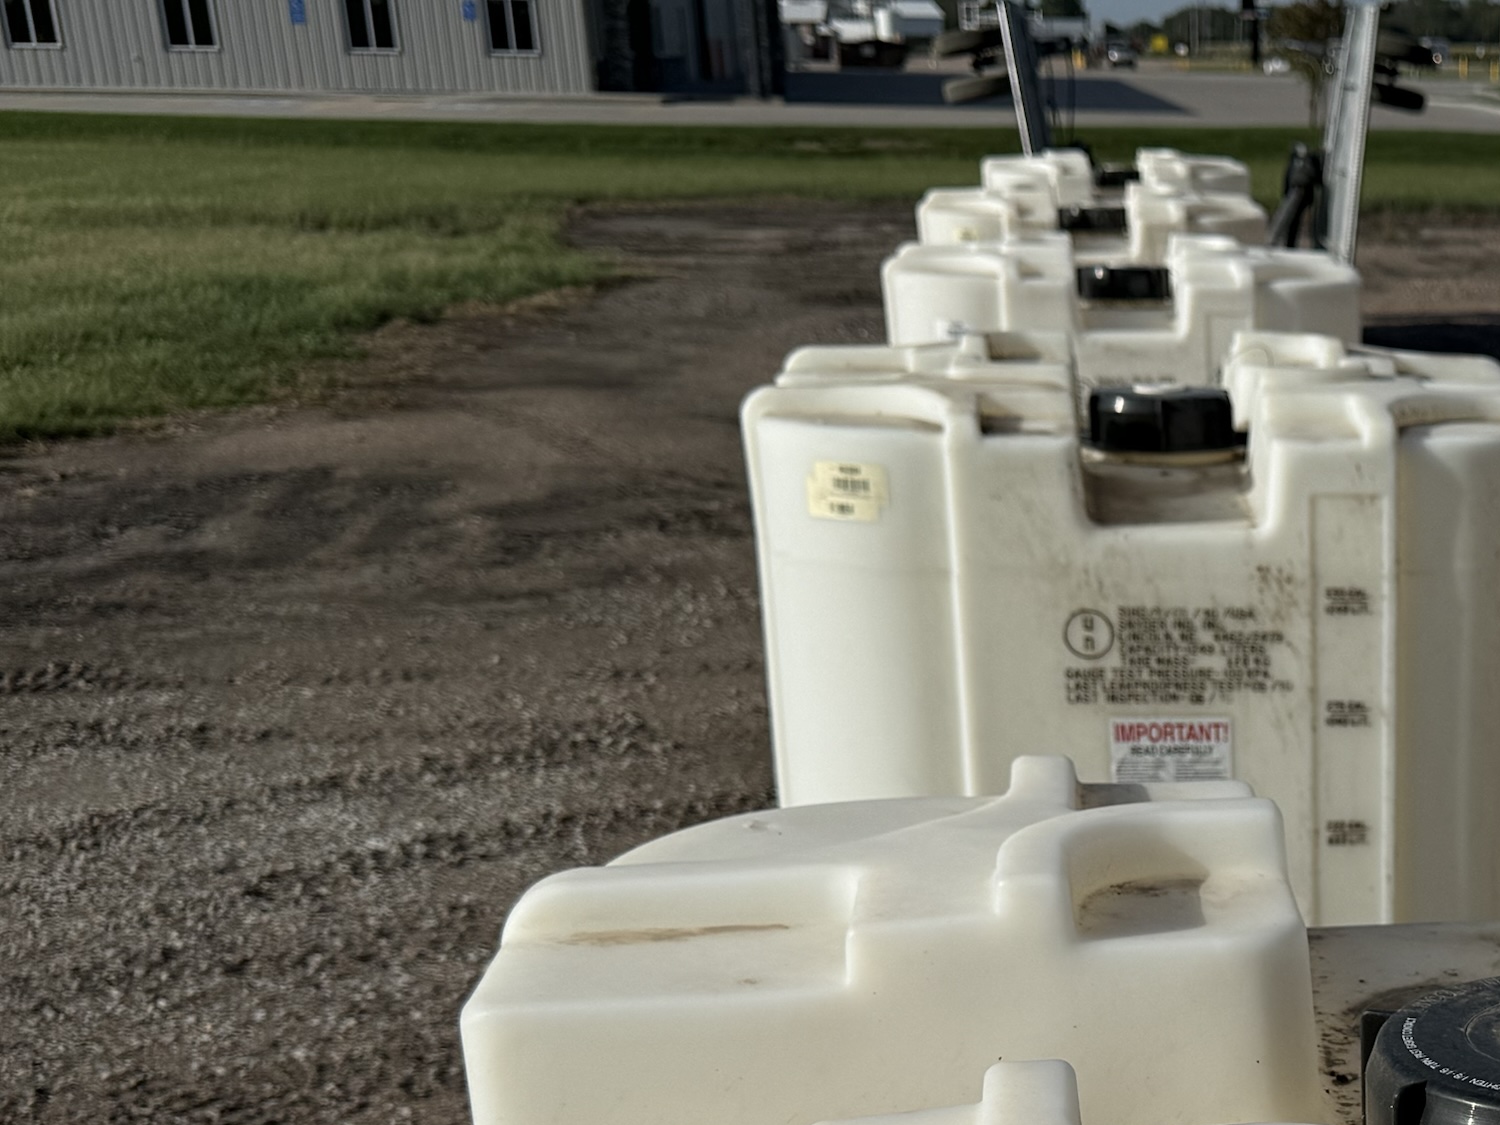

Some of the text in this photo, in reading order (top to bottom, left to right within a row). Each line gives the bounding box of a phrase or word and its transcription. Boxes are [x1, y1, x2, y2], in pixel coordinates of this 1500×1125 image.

[1113, 722, 1230, 743] IMPORTANT!
[1130, 744, 1214, 757] READ CAREFULLY
